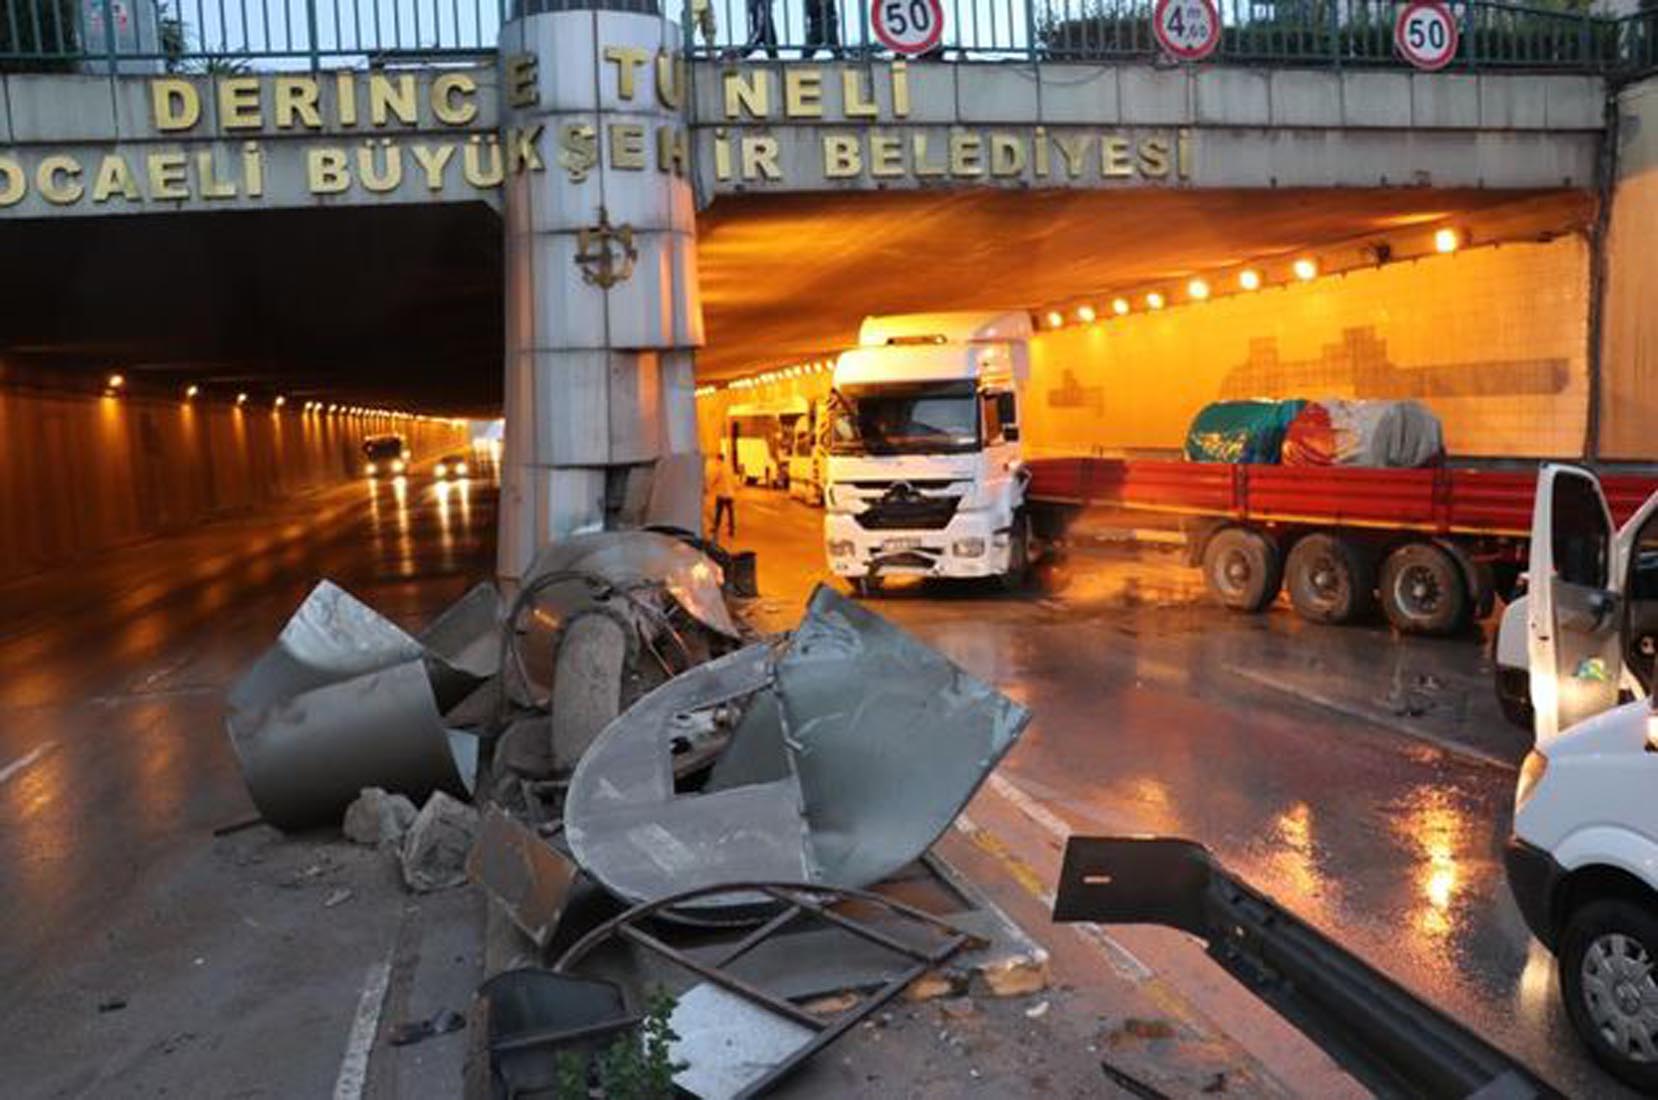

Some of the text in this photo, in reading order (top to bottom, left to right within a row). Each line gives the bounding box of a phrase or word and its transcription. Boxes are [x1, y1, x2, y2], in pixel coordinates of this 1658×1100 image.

[886, 0, 930, 35] 50
[1409, 19, 1445, 49] 50
[823, 126, 1192, 180] BELEDİYESİ
